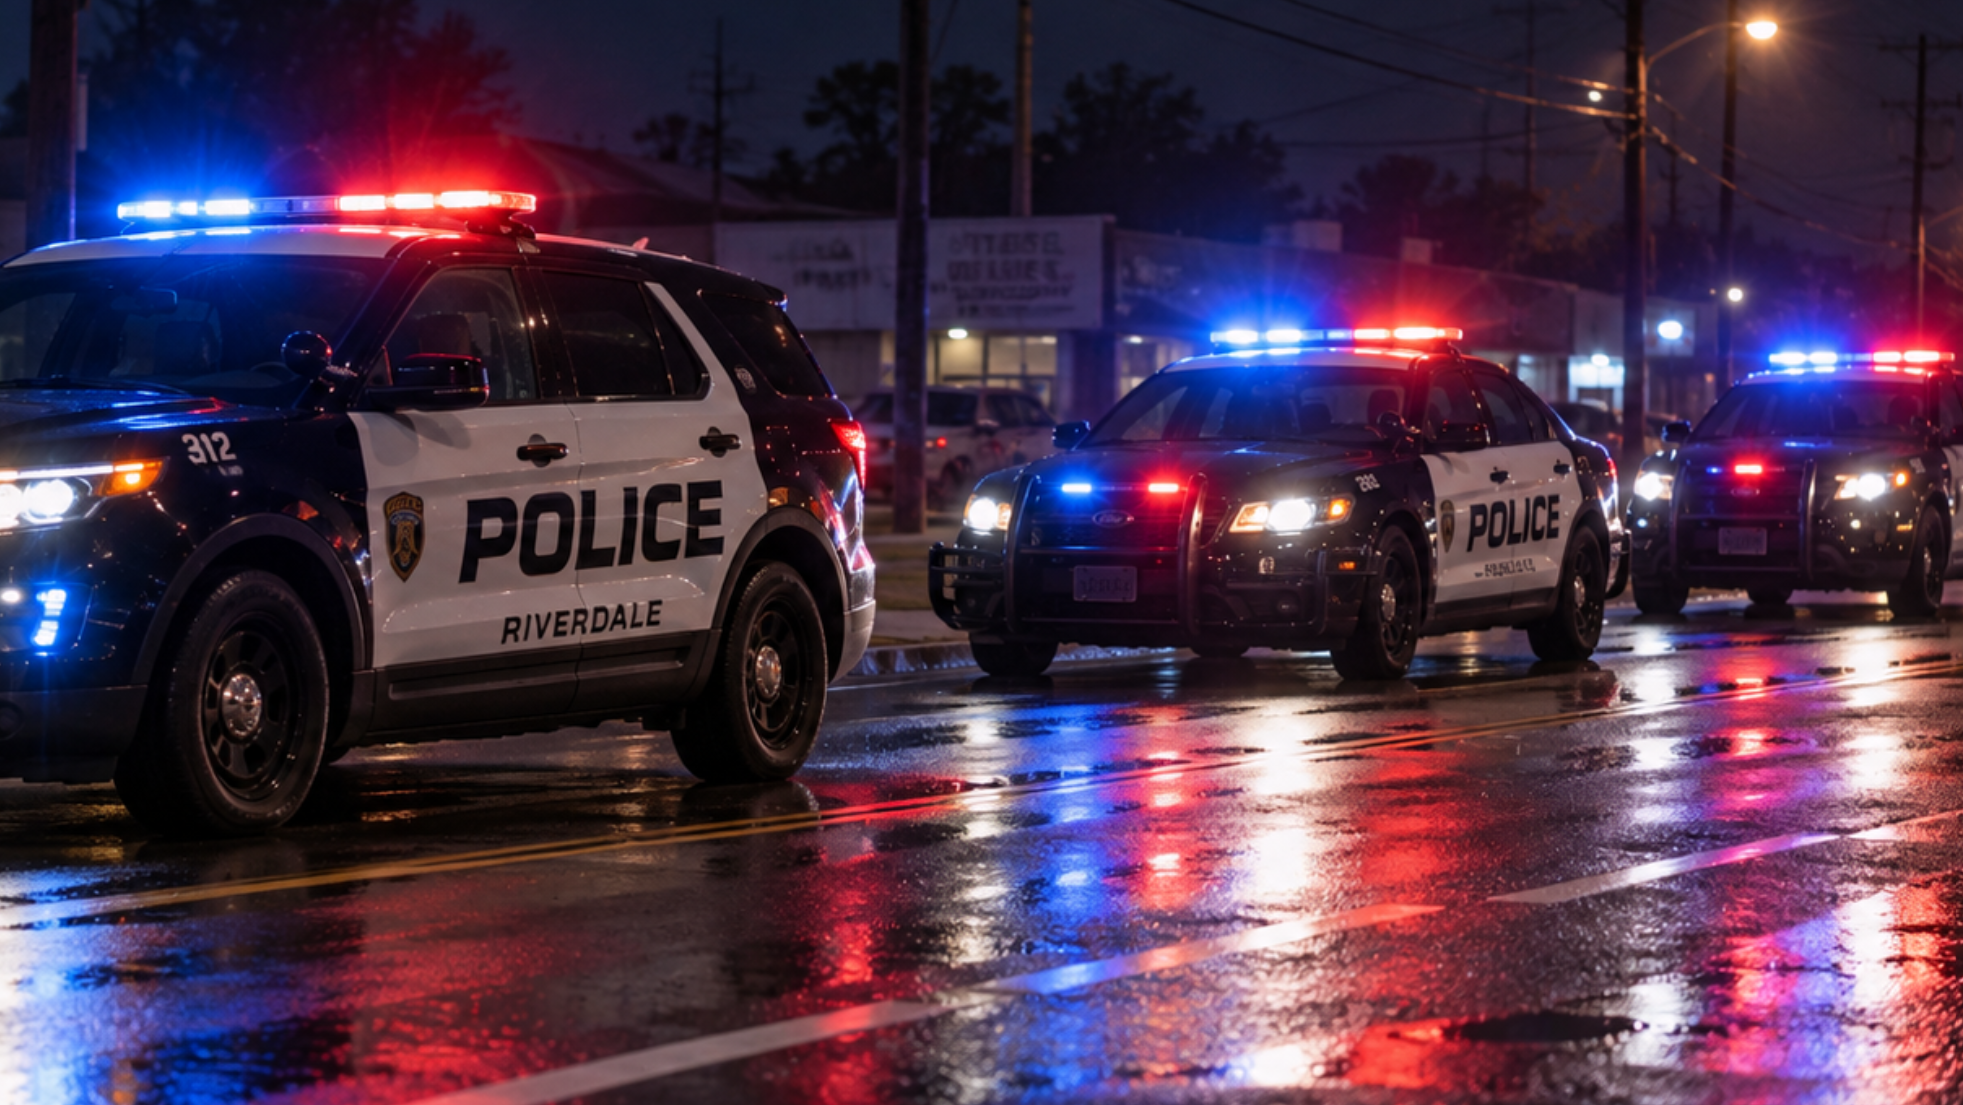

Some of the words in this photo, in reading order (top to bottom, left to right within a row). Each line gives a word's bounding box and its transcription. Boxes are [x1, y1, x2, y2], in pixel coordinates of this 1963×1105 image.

[181, 431, 237, 465] 312
[458, 479, 725, 584] POLICE
[1466, 494, 1560, 553] POLICE
[501, 600, 663, 645] RIVERDALE
